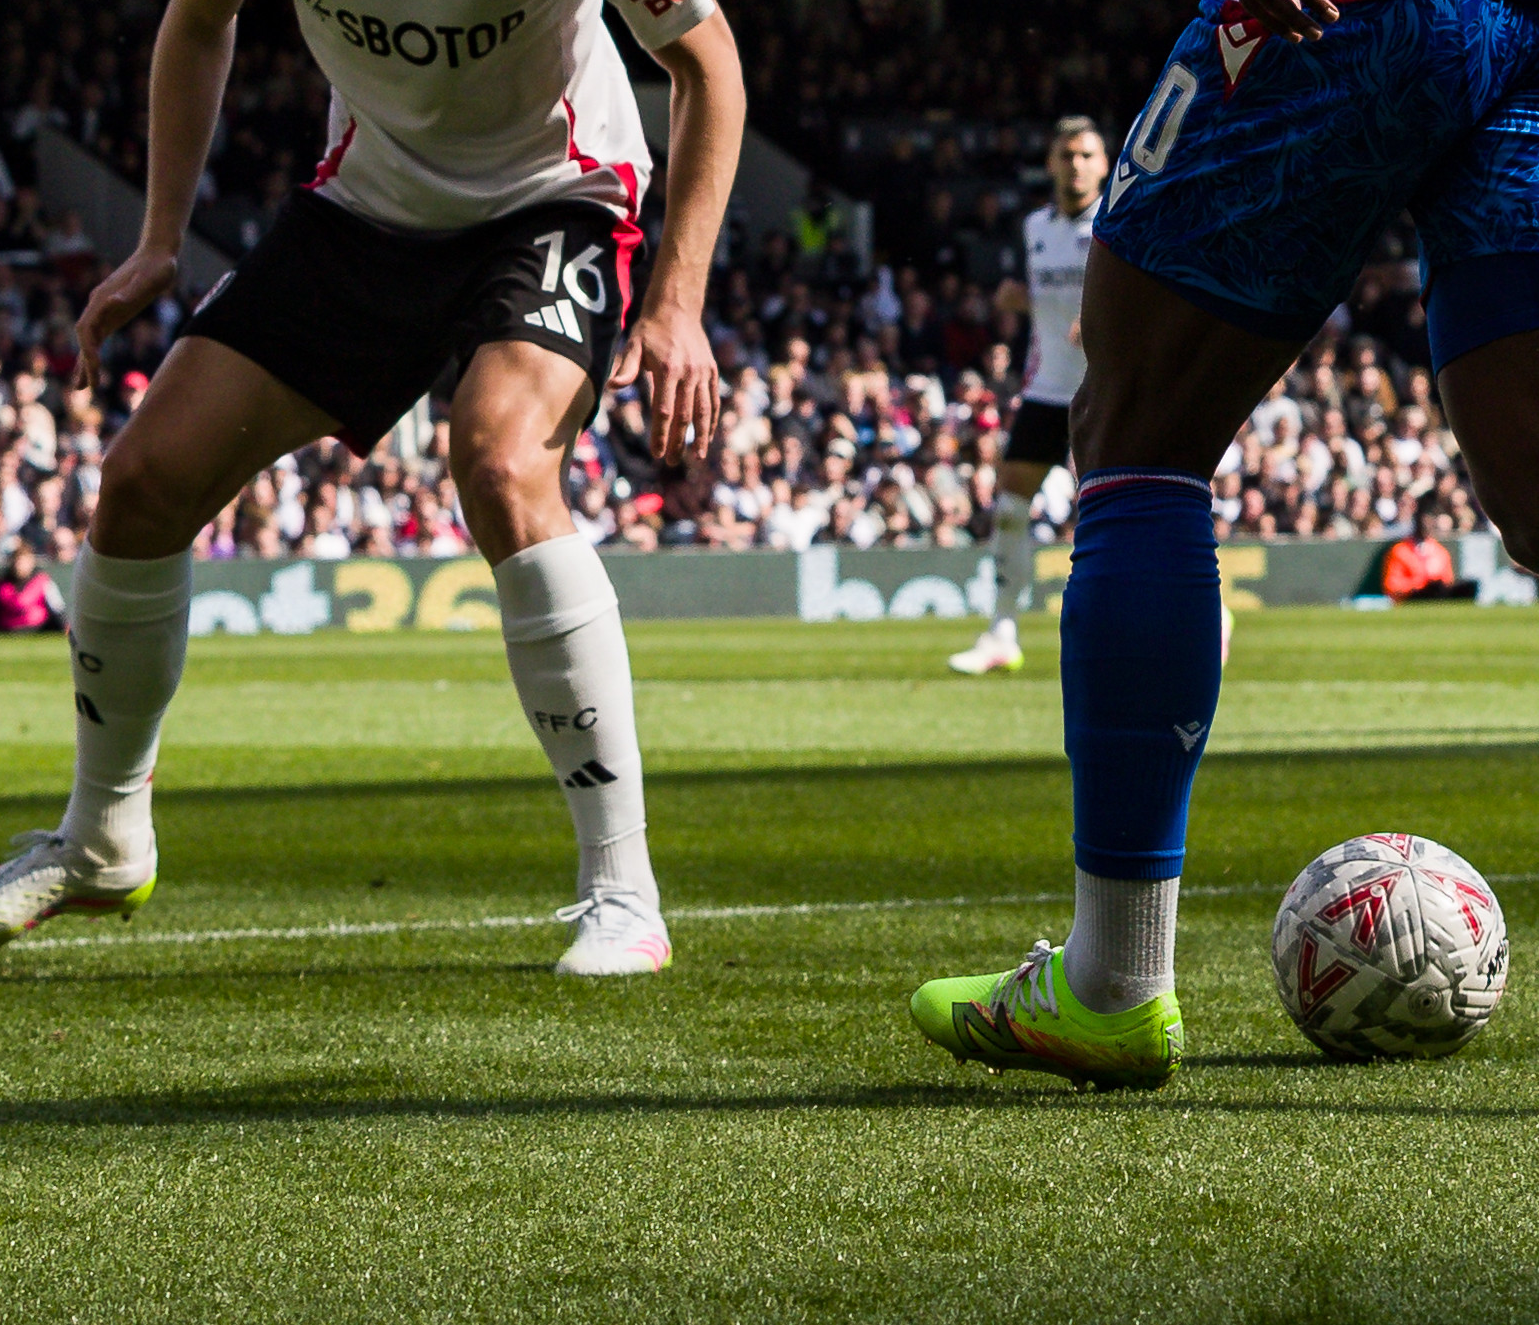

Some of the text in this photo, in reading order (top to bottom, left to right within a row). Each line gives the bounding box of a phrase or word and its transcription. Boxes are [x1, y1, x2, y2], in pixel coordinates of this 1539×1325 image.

[335, 9, 526, 69] SBOTOP
[533, 230, 607, 314] 16
[534, 707, 598, 733] FFC
